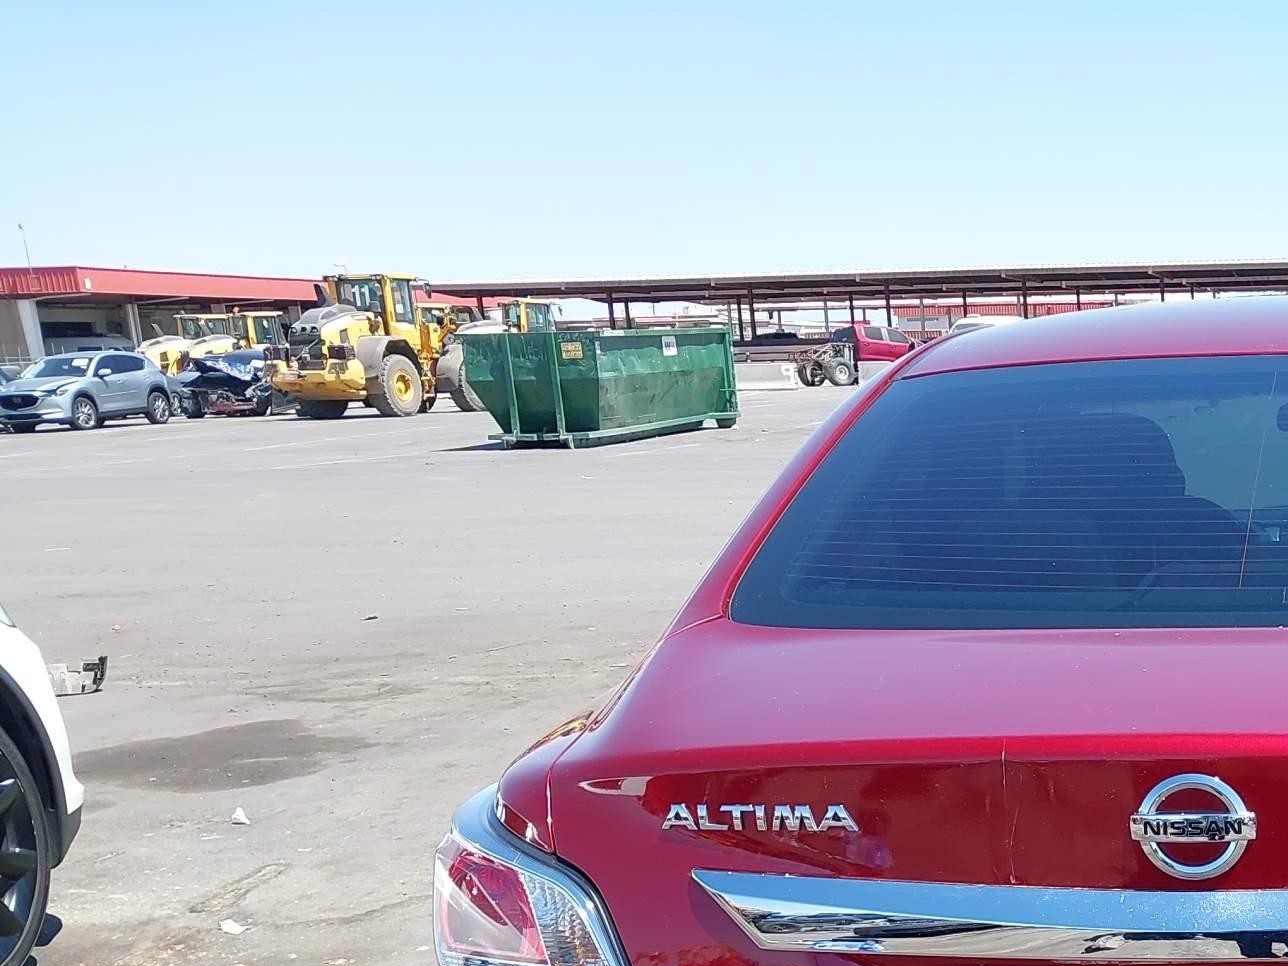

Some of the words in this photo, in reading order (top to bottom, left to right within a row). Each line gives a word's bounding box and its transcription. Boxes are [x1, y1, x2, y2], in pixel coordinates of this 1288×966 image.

[351, 283, 370, 307] 11
[661, 803, 860, 832] ALTIMA
[1143, 819, 1243, 836] NISSAN
